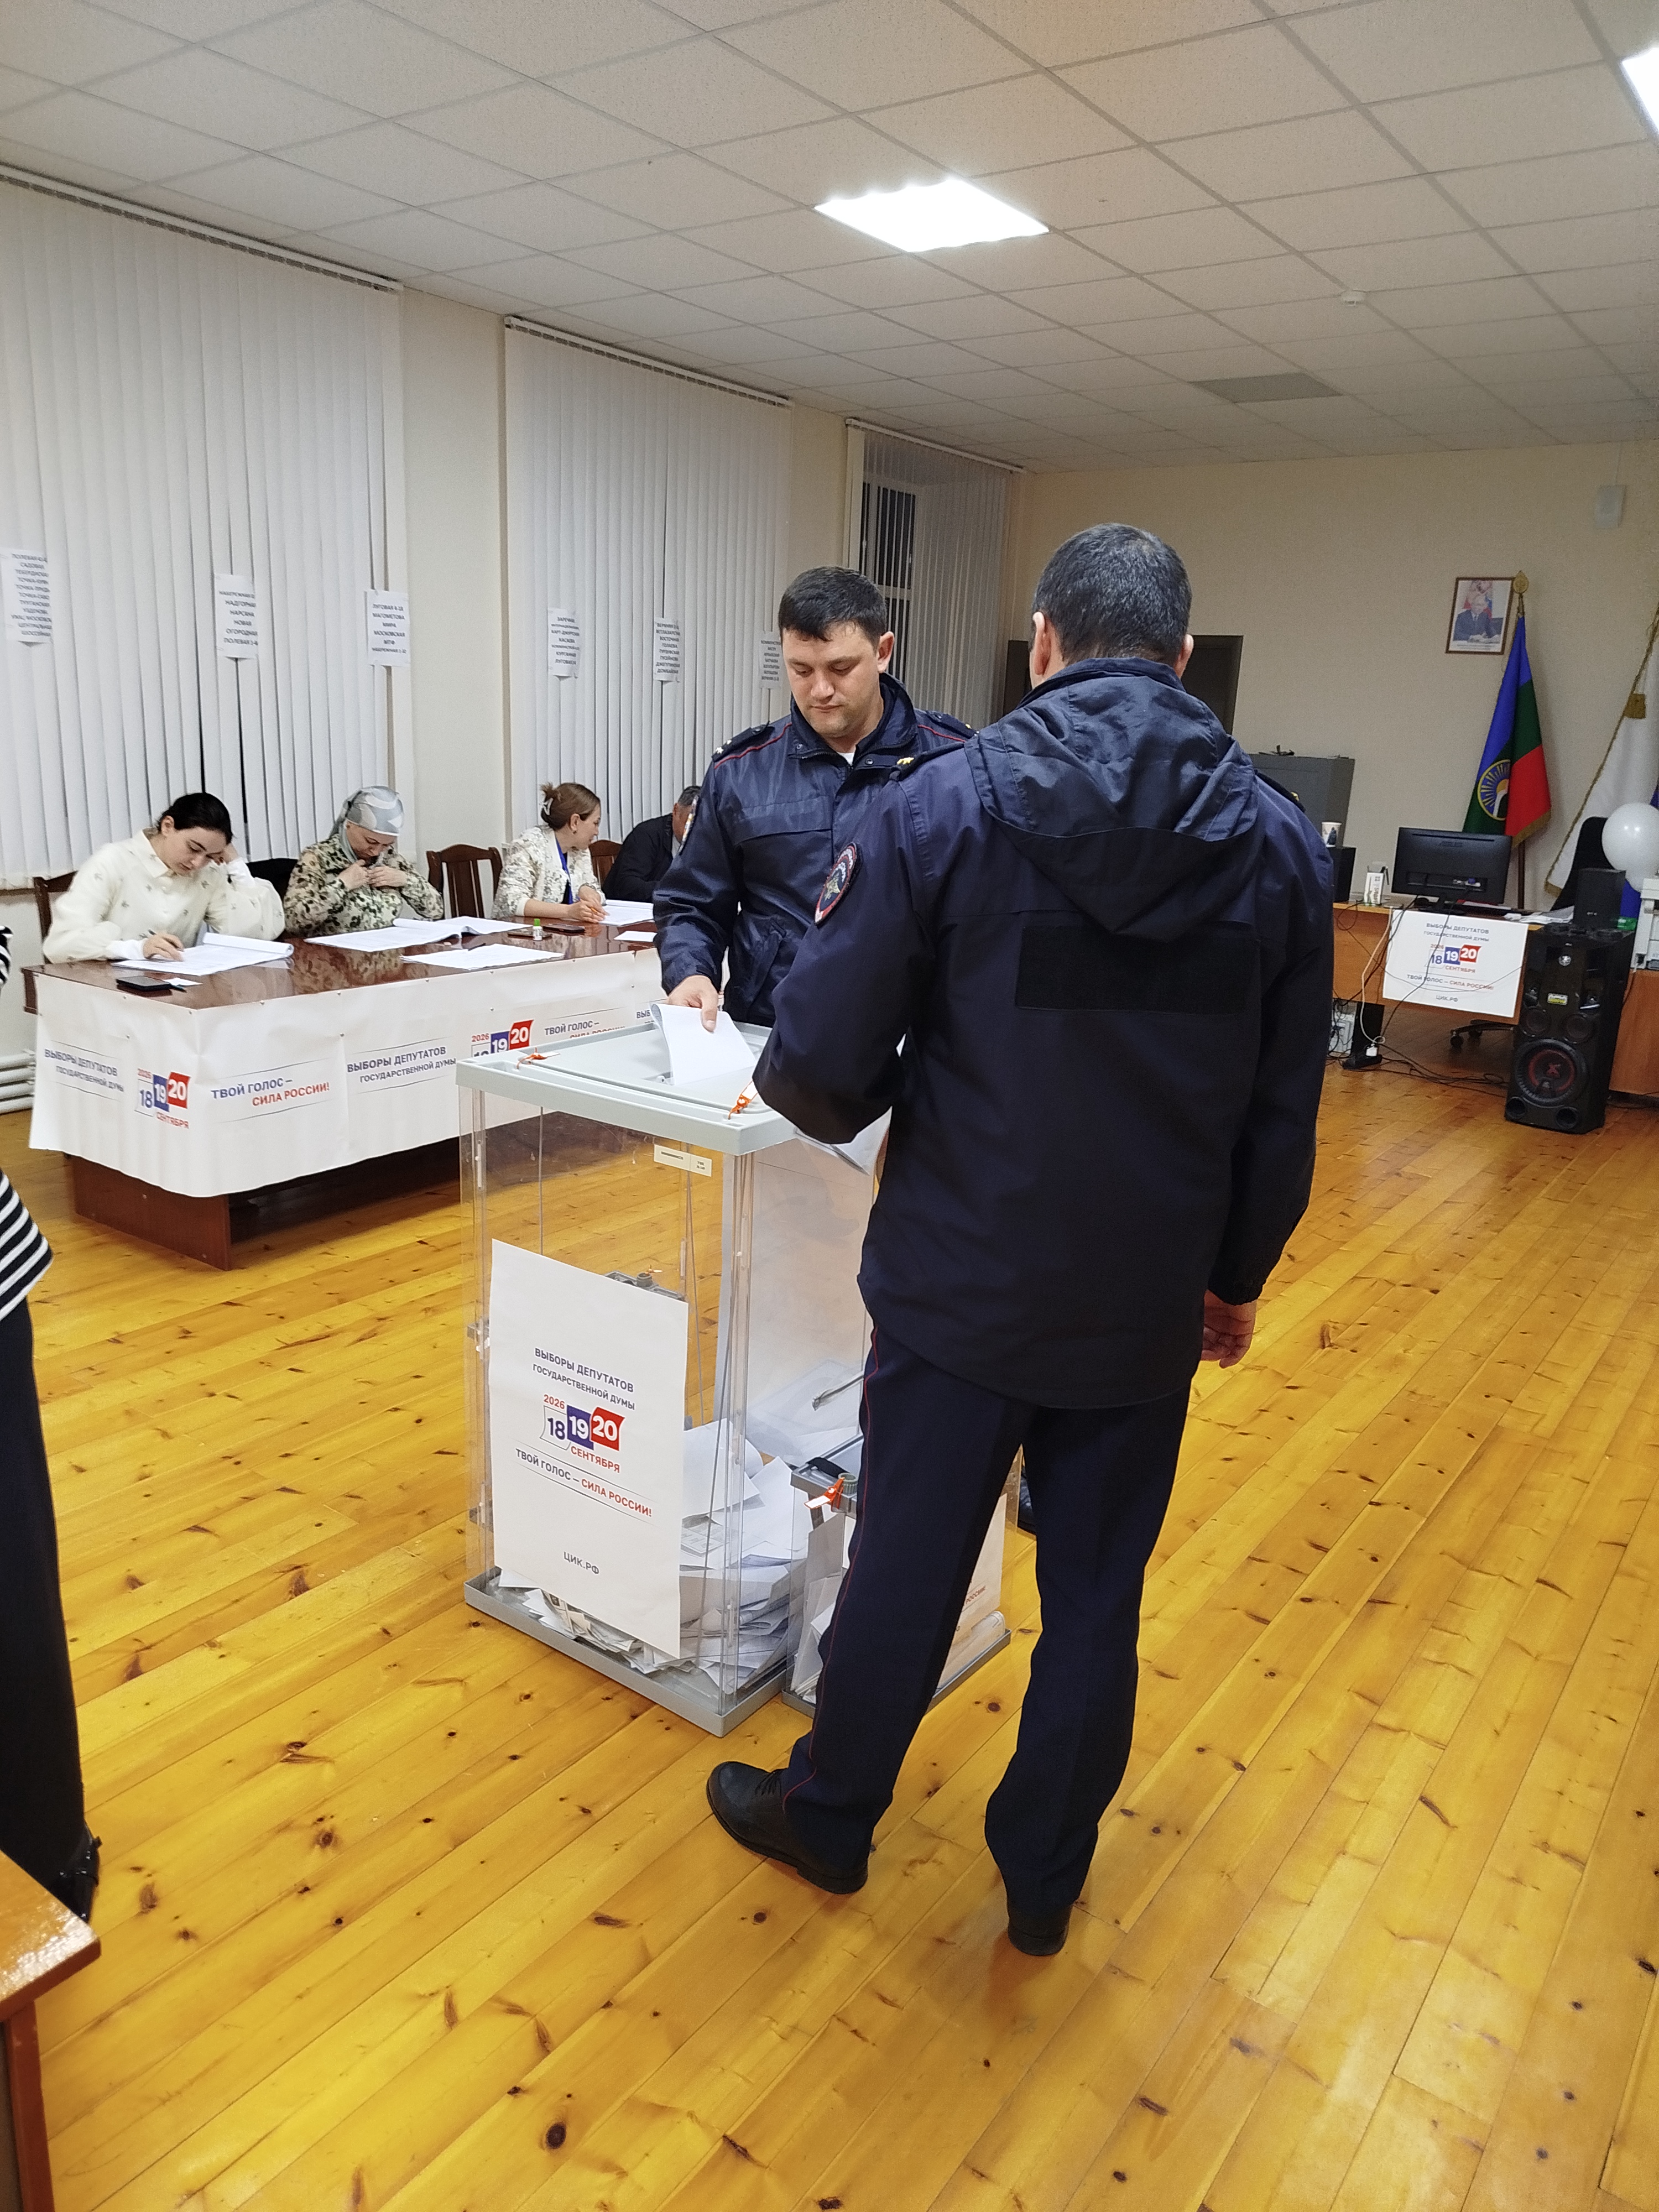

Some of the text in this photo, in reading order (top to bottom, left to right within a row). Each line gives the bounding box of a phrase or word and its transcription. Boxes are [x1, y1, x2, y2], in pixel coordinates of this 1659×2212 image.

[1453, 926, 1489, 934] ДЕПУТАТОВ
[1431, 948, 1477, 964] 18 19 20
[637, 1010, 651, 1019] ВЫБ
[472, 1033, 489, 1042] 2026
[492, 1027, 529, 1053] 19 20
[545, 1023, 566, 1036] ТВОЙ
[568, 1020, 593, 1032] ГОЛОС
[44, 1048, 118, 1077] ВЫБОРЫ ДЕПУТАТОВ
[347, 1046, 446, 1073] ВЫБОРЫ ДЕПУТАТОВ
[360, 1058, 456, 1083] ГОСУДАРСТВЕННОЙ ДУМЫ
[139, 1079, 187, 1108] 18 19 20
[211, 1083, 245, 1099] ТВОЙ
[248, 1078, 283, 1093] ГОЛОС
[252, 1082, 330, 1107] СИЛА РОССИИ!
[156, 1112, 189, 1129] СЕНТЯБРЯ
[535, 1348, 634, 1392] ВЫБОРЫ ДЕПУТАТОВ
[533, 1364, 635, 1410] ГОСУДАРСТВЕННОЙ ДУМЫ
[544, 1394, 565, 1410] 2026
[547, 1415, 618, 1441] 18 19 20
[571, 1446, 620, 1473] СЕНТЯБРЯ
[516, 1448, 539, 1465] ТВОЙ
[541, 1460, 571, 1480] ГОЛОС
[581, 1478, 607, 1497] СИЛА
[609, 1491, 652, 1517] РОССИИ!
[564, 1551, 599, 1574] ЦИК.РФ
